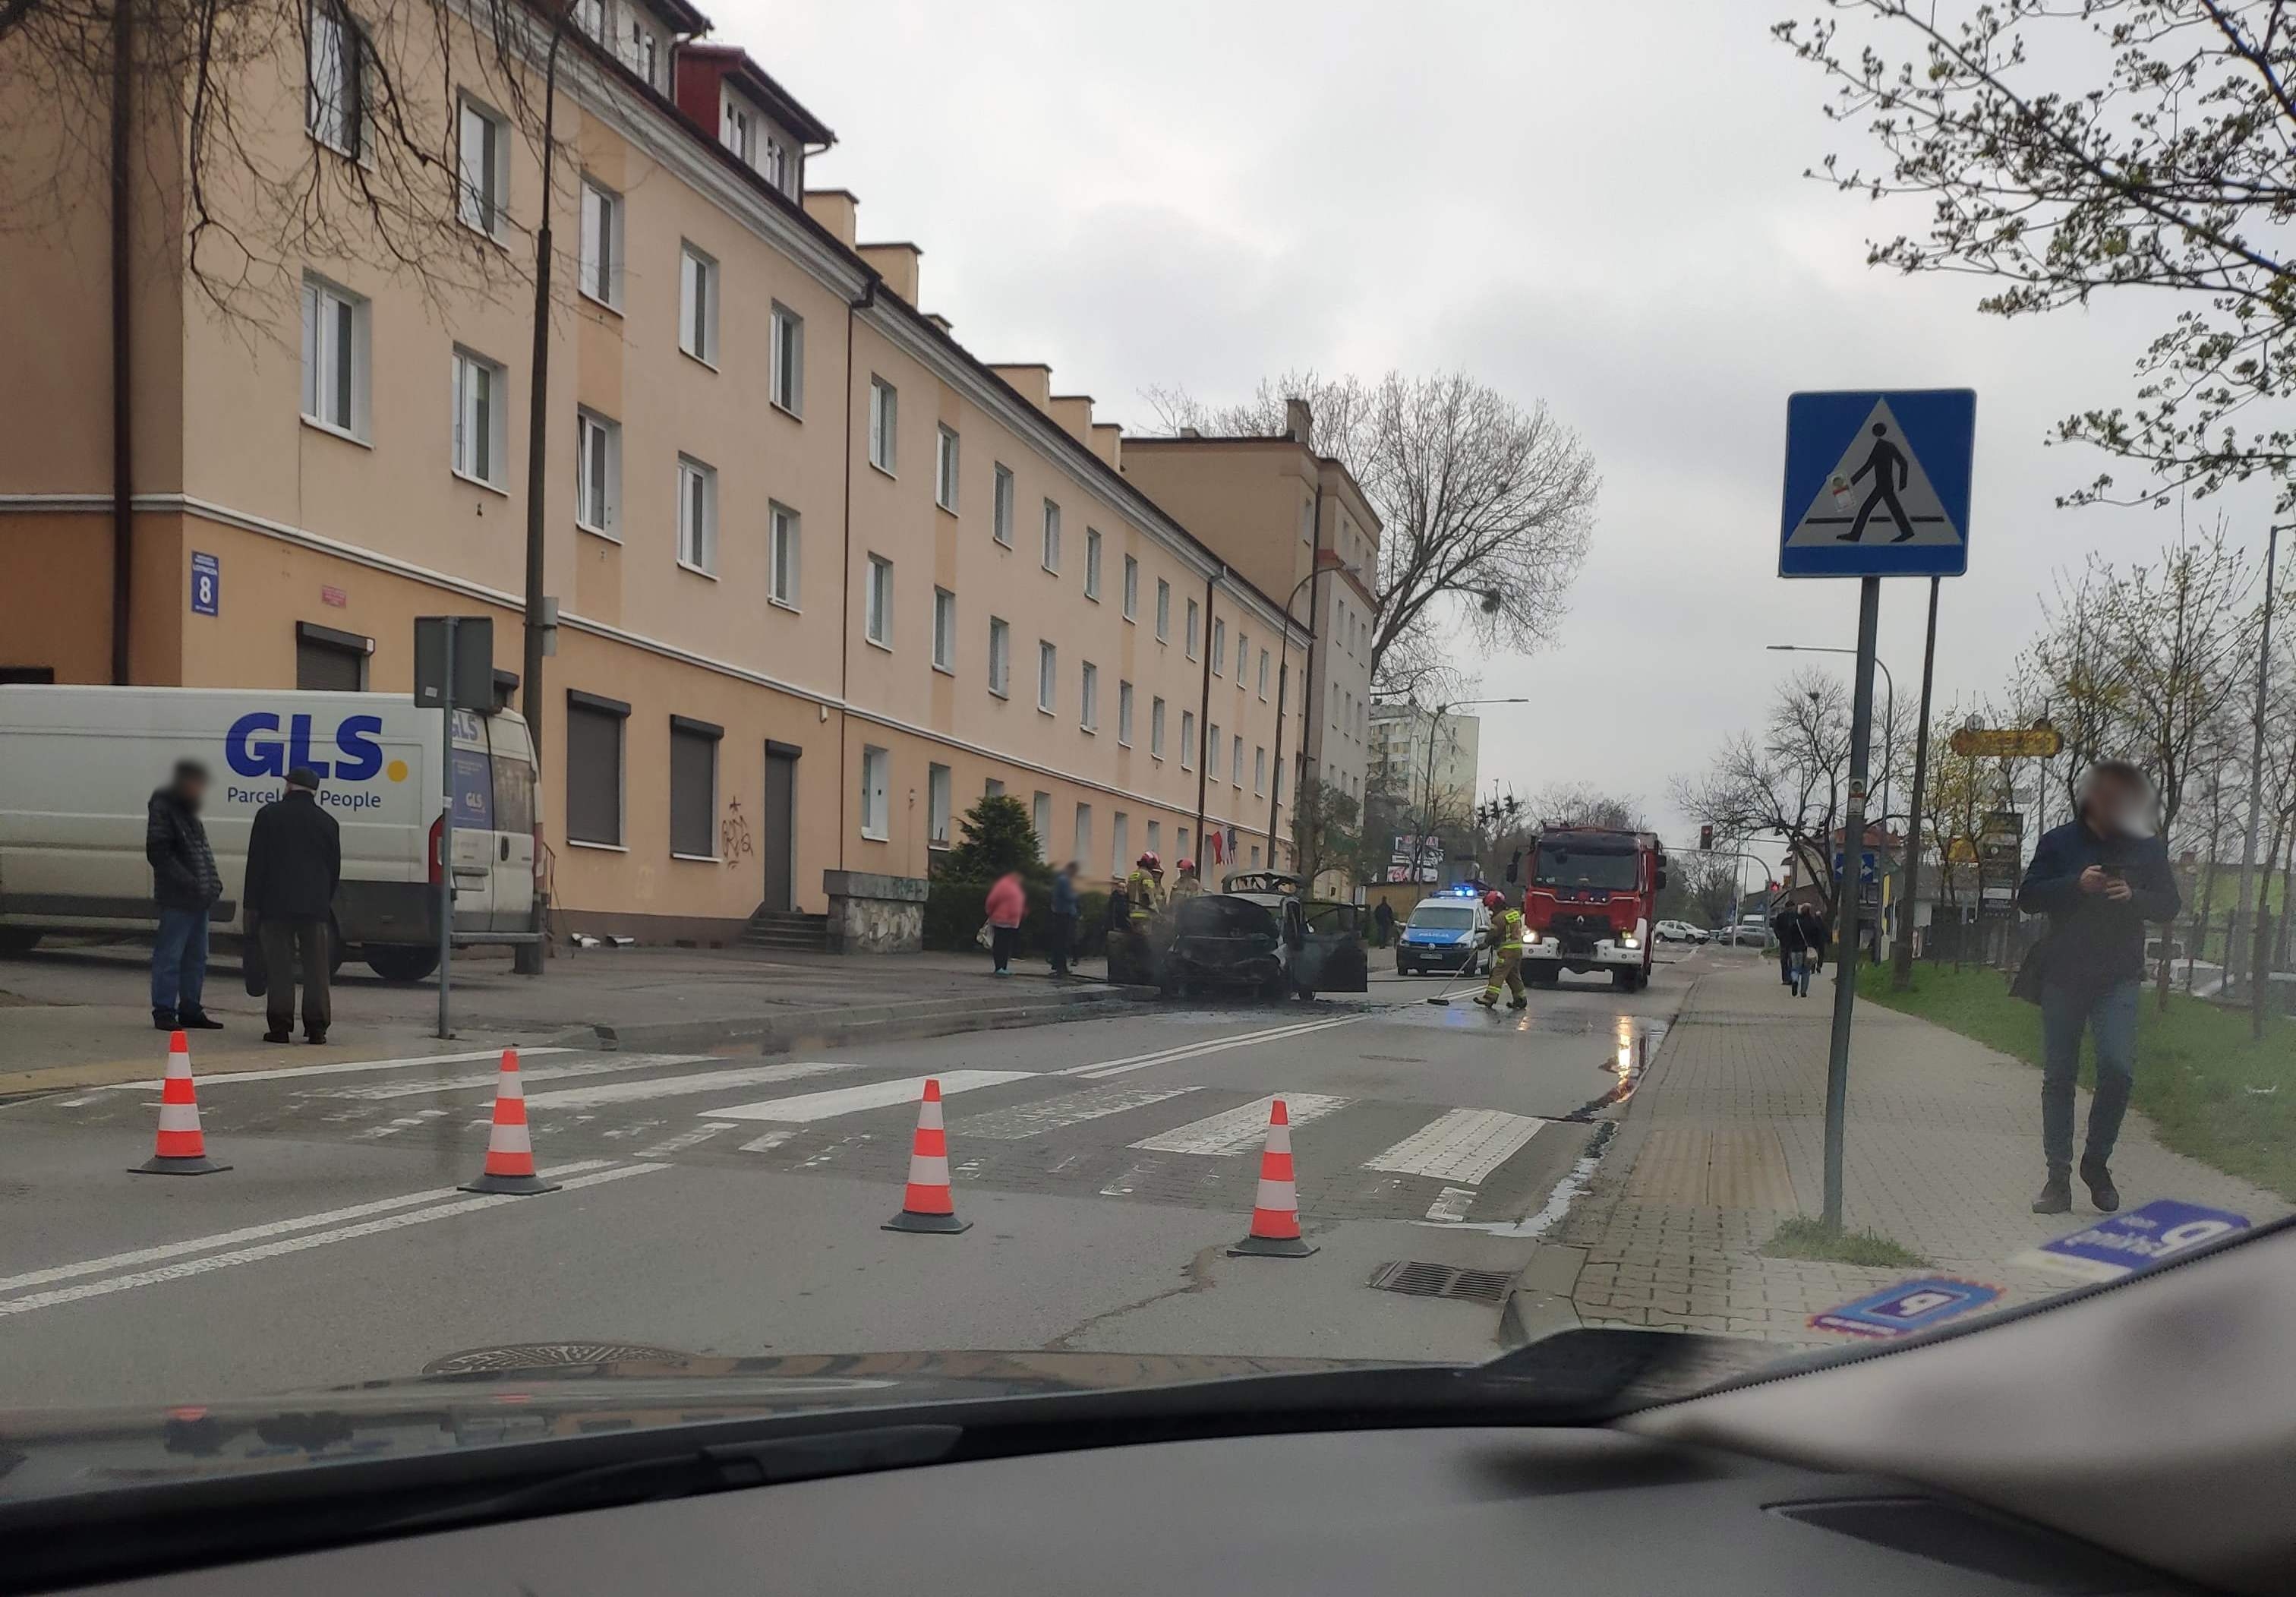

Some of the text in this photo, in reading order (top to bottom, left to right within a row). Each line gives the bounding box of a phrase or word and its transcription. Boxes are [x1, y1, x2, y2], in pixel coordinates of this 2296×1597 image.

[199, 576, 211, 604] 8
[227, 787, 381, 812] Parcel People
